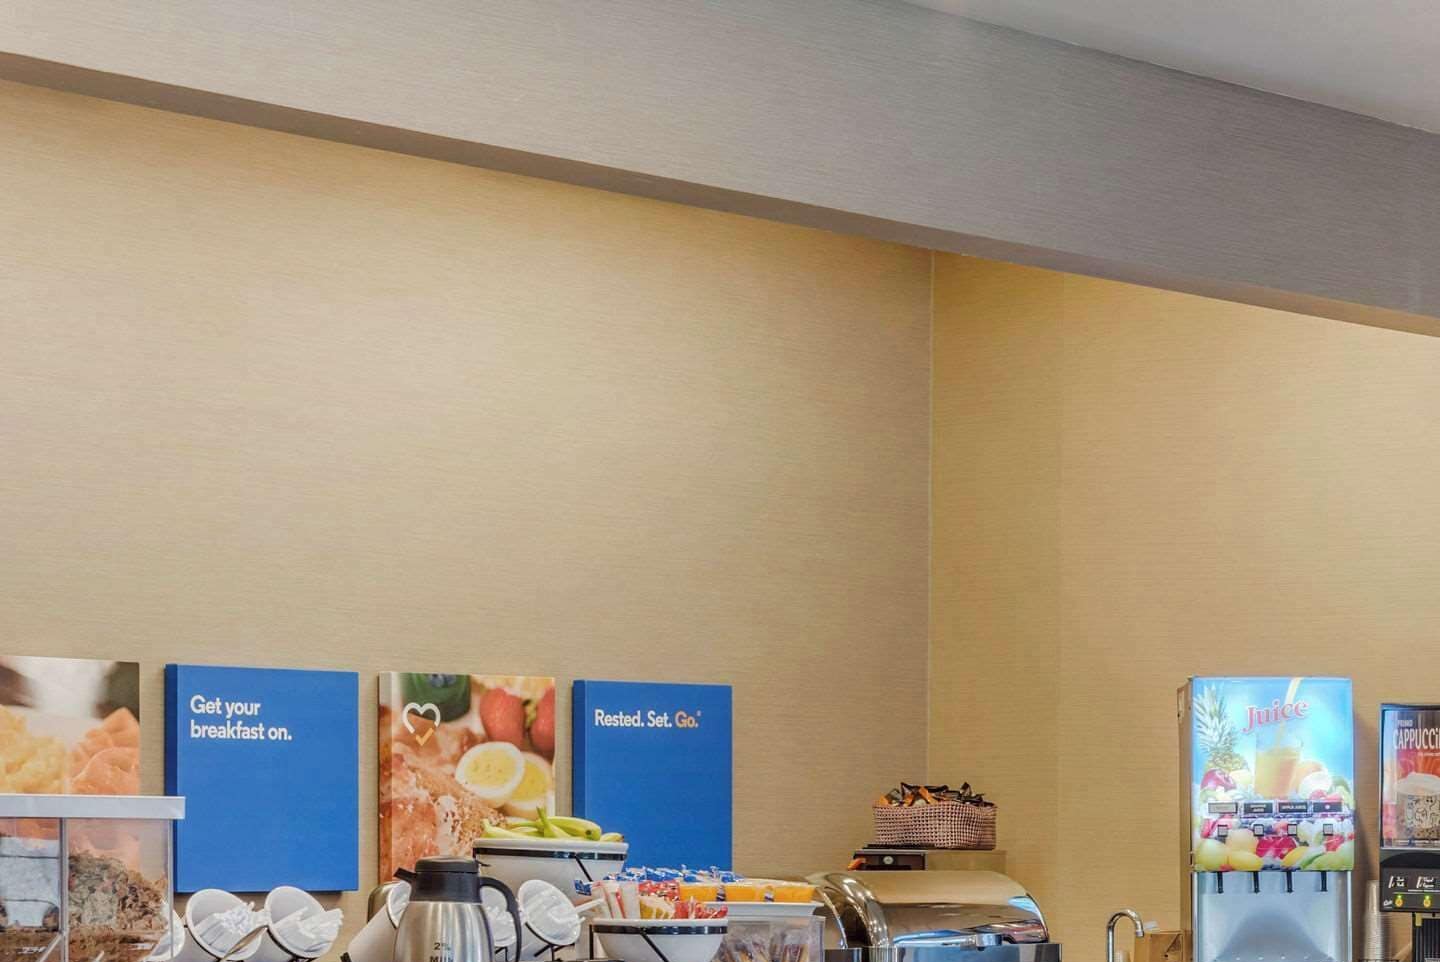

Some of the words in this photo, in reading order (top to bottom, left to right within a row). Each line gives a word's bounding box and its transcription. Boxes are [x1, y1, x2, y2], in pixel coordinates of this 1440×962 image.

[190, 694, 222, 714] Get
[225, 702, 261, 719] your
[593, 708, 645, 728] Rested.
[647, 710, 673, 728] Set.
[1240, 699, 1310, 734] Juice
[190, 719, 265, 740] breakfast
[267, 727, 294, 741] on.
